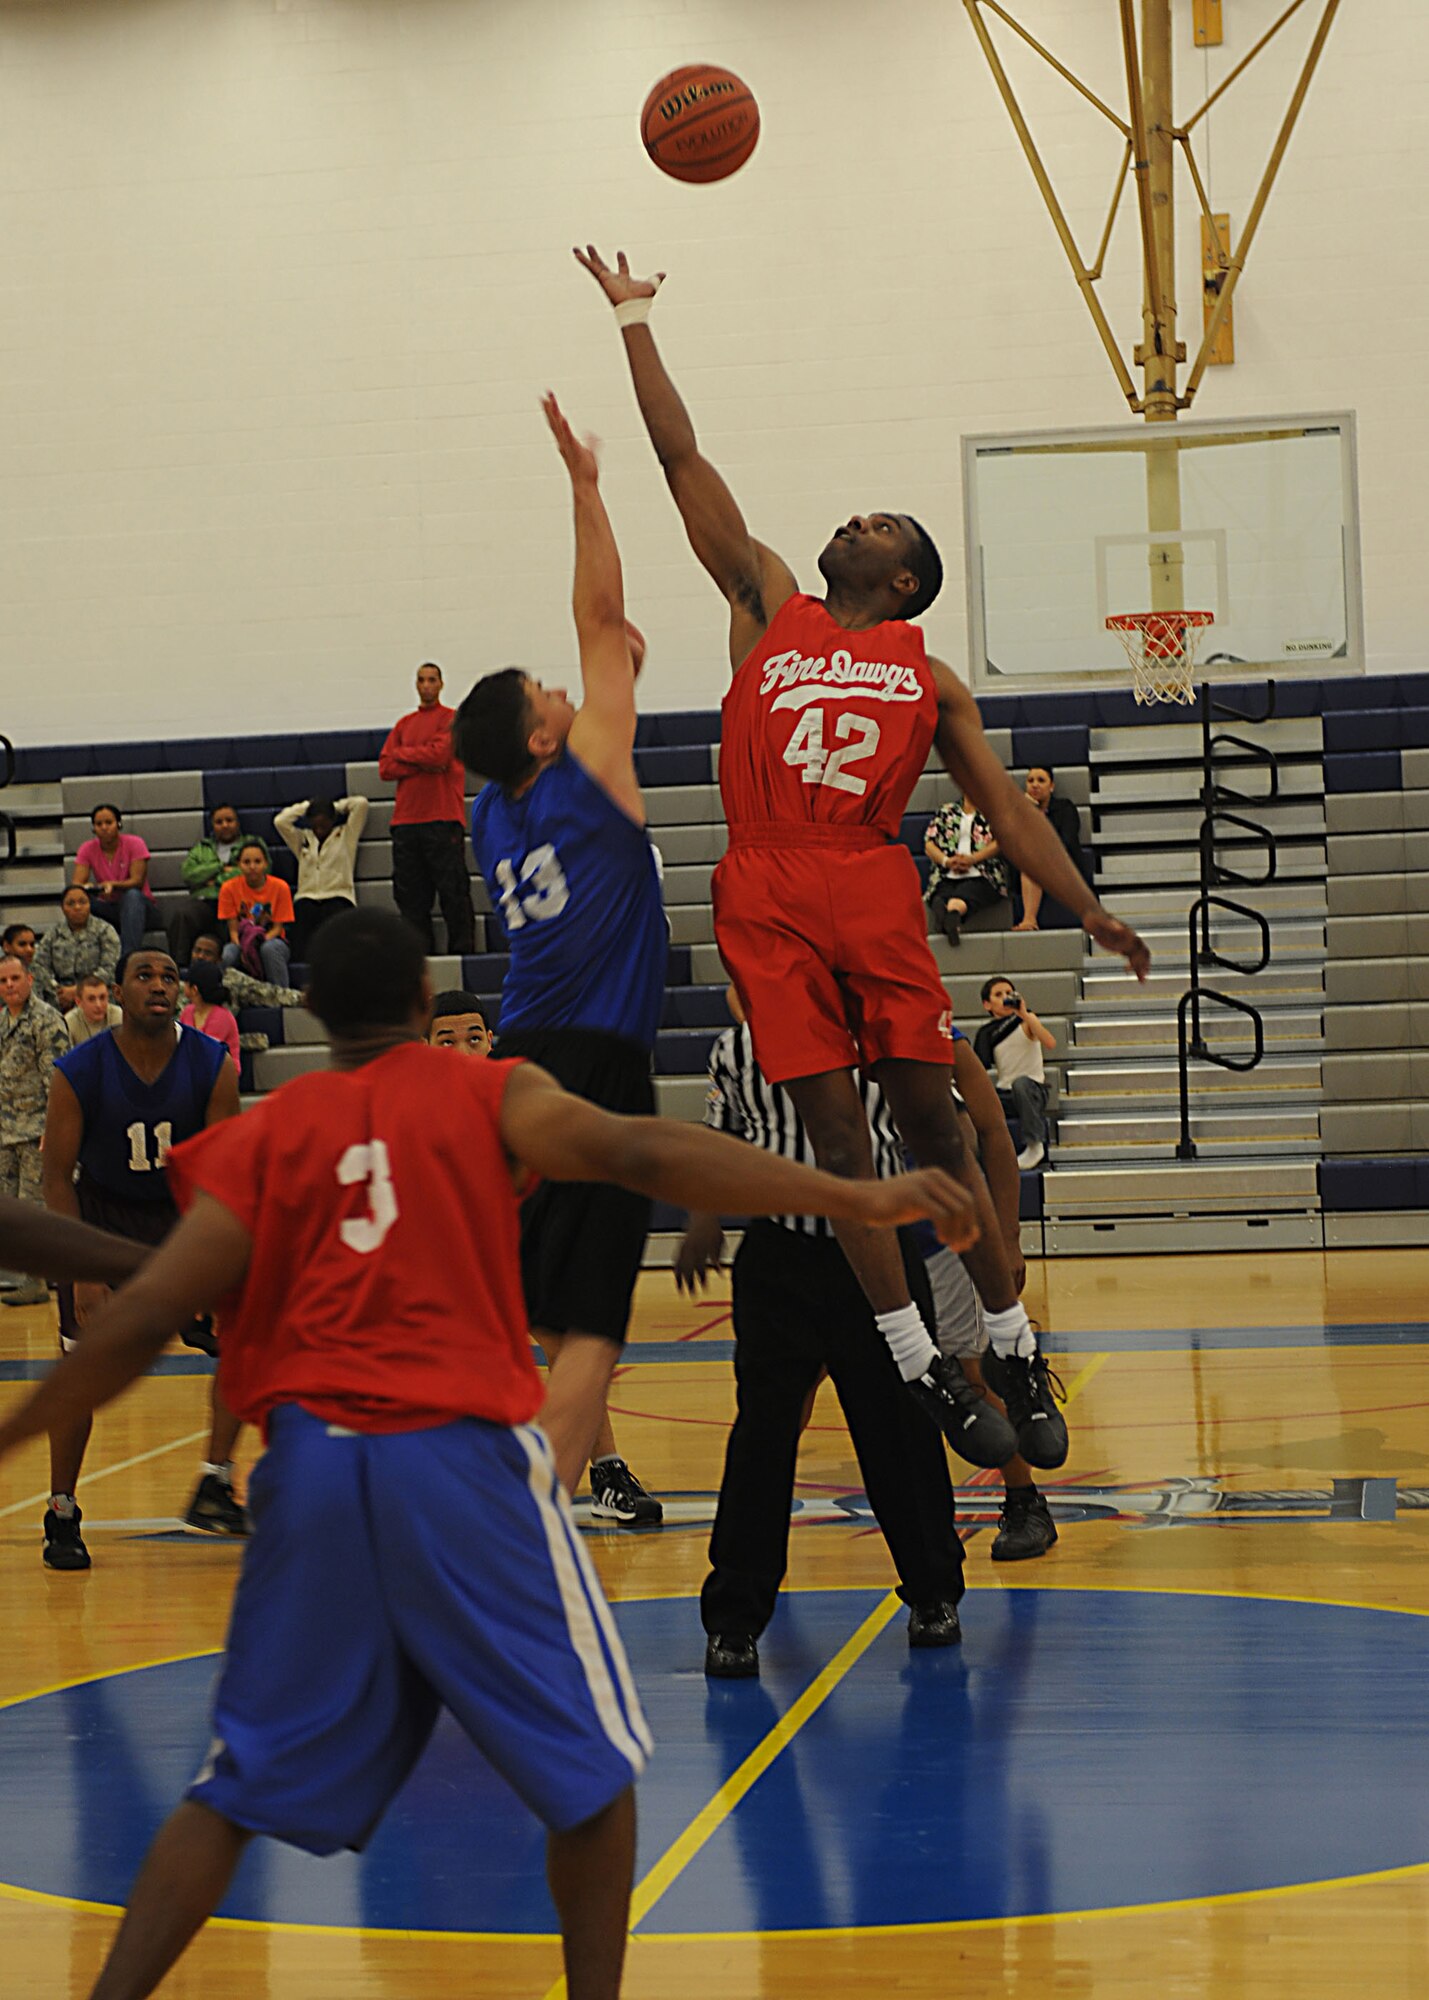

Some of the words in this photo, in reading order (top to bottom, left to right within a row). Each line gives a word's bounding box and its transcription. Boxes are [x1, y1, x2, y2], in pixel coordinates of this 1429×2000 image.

[659, 80, 735, 121] Wilson
[1285, 644, 1297, 652] NO
[1298, 642, 1332, 651] DUNKING
[759, 649, 826, 695] Fire
[822, 649, 924, 702] Dawgs
[782, 707, 881, 796] 42
[495, 842, 571, 930] 13
[127, 1121, 172, 1171] 11
[335, 1138, 399, 1254] 3
